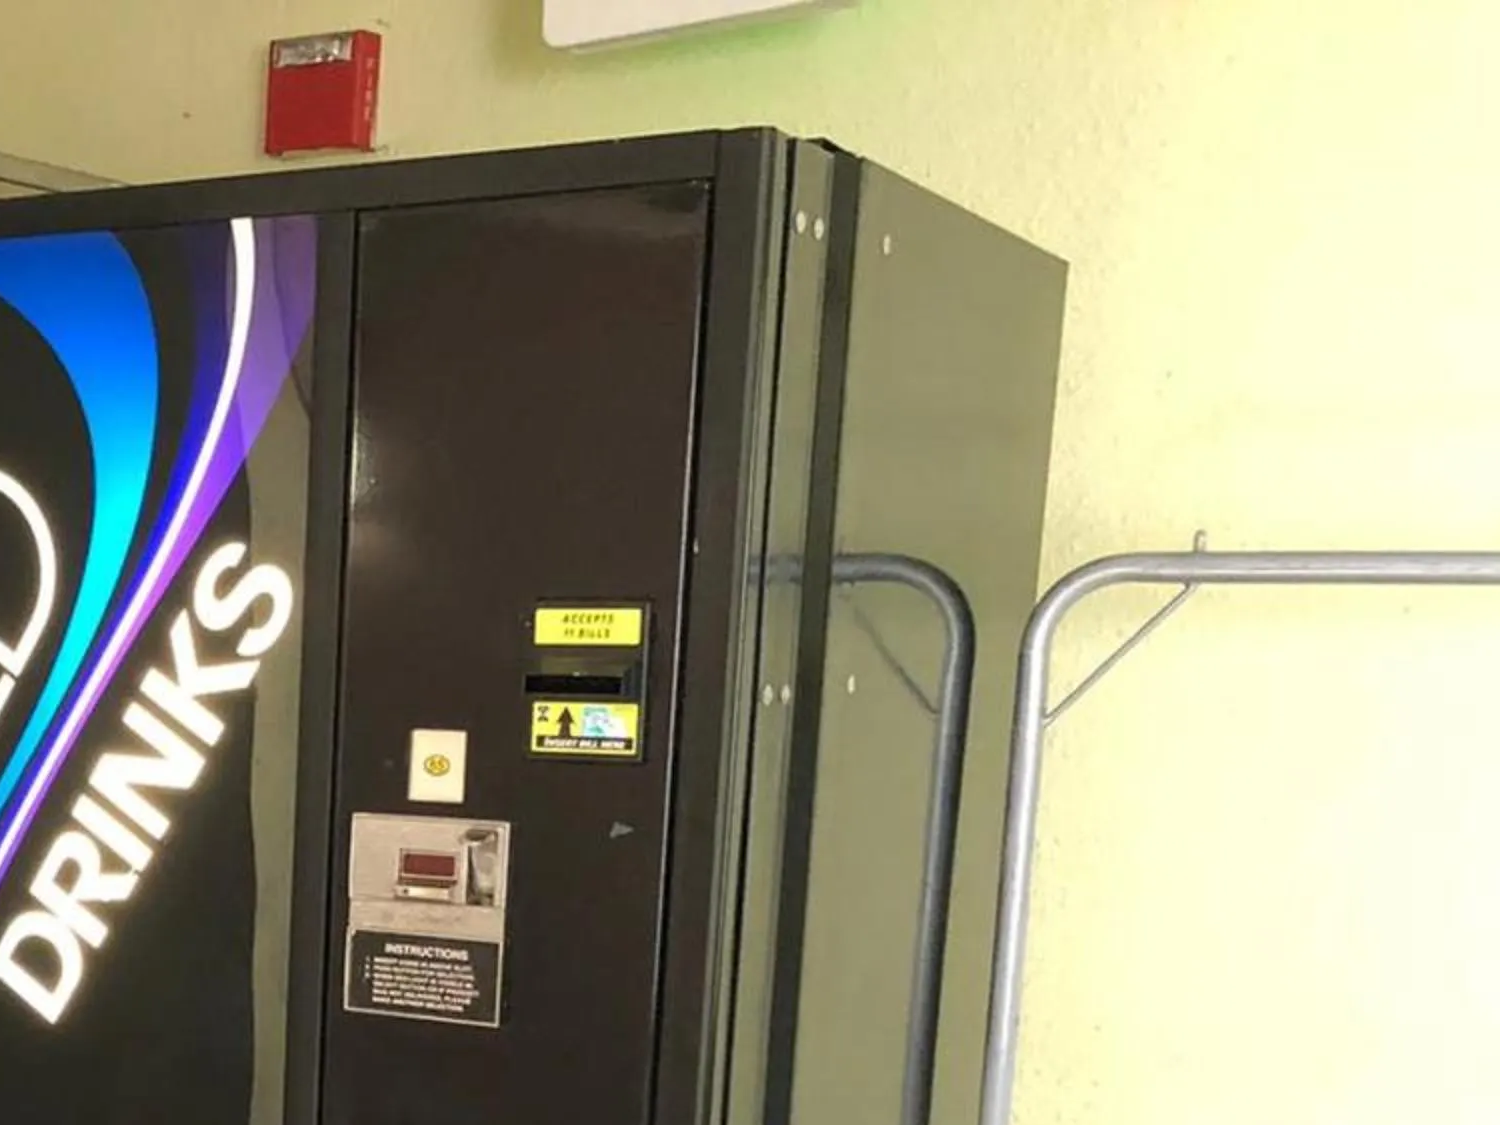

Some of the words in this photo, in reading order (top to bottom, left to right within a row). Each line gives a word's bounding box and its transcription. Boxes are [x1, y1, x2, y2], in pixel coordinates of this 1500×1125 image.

[562, 613, 615, 625] ACCEPTS
[578, 627, 611, 640] BILLS
[384, 943, 469, 961] INSTRUCTIONS
